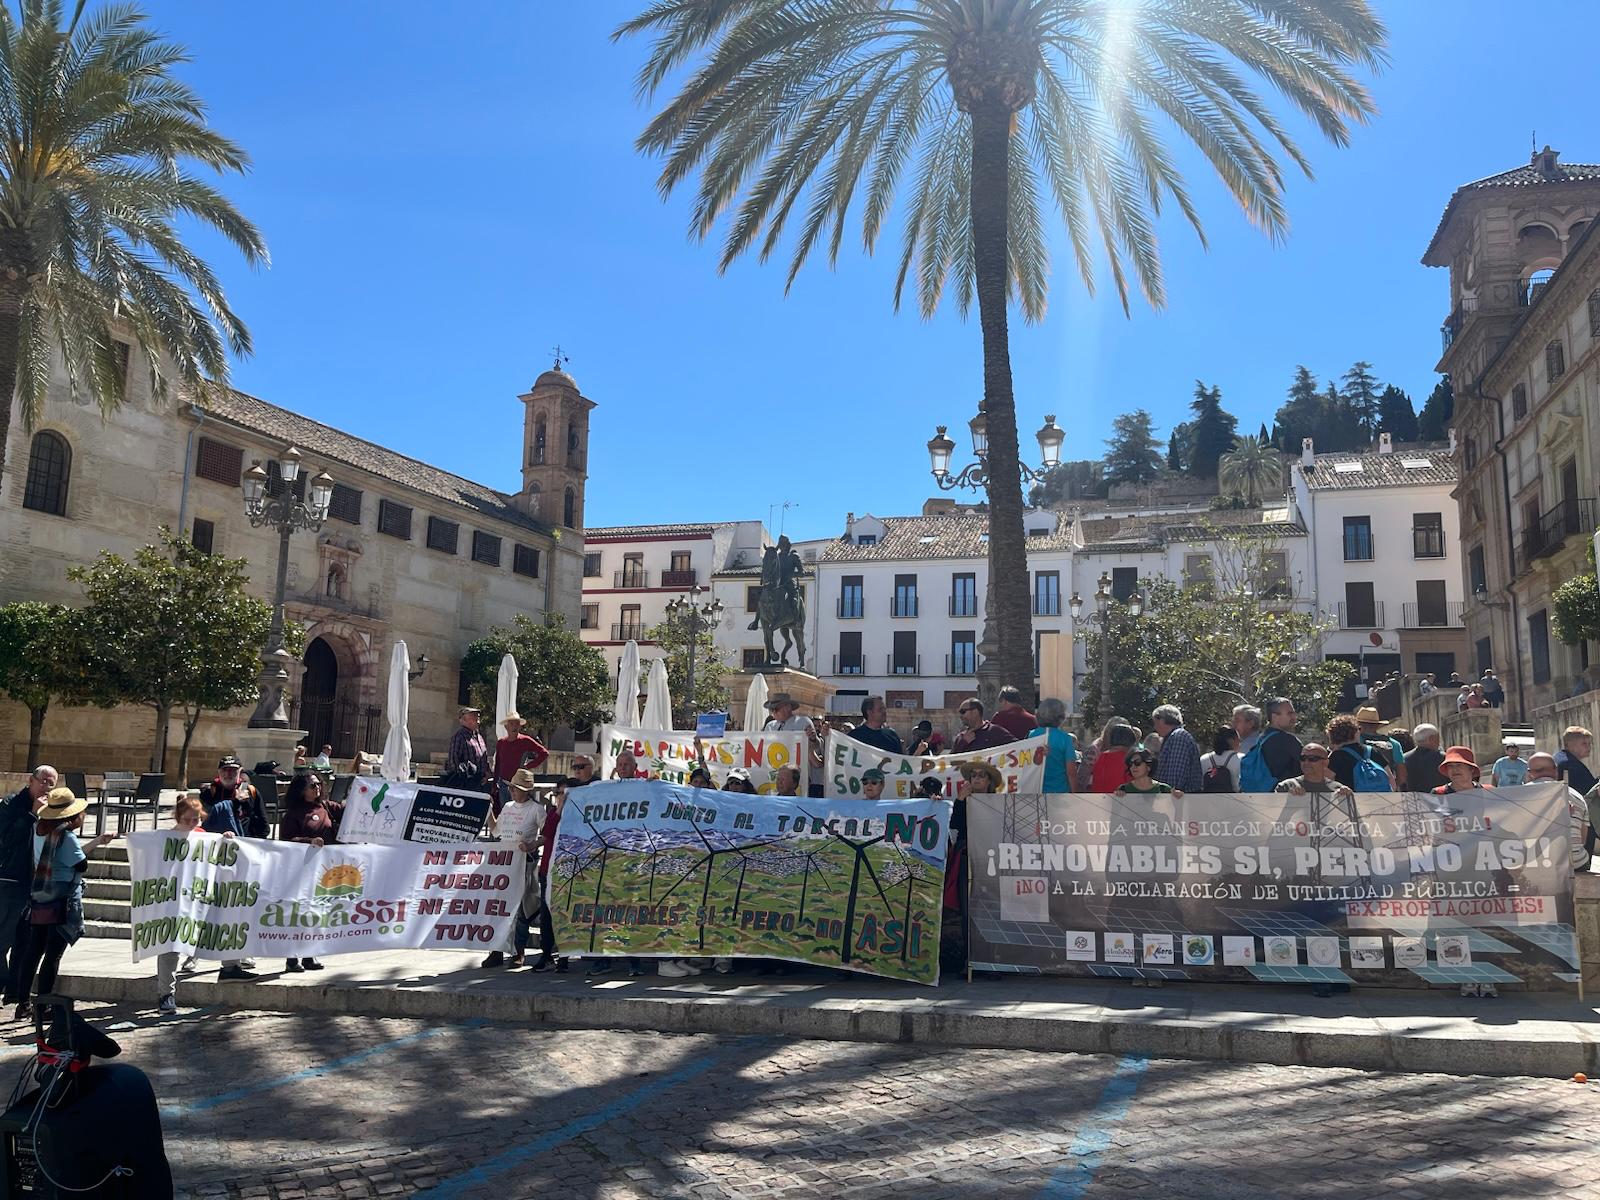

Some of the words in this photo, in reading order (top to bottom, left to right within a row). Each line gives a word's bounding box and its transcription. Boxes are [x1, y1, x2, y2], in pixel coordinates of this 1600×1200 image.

[835, 743, 862, 767] EL
[440, 795, 465, 809] NO
[415, 827, 460, 840] RENOVABLES
[583, 801, 650, 824] EOLICAS
[660, 802, 717, 824] JUNTO
[733, 813, 755, 830] AL
[778, 815, 873, 837] TORCAL
[885, 813, 939, 850] NO
[1085, 820, 1128, 837] UNA
[1392, 821, 1406, 837] Y
[1416, 816, 1492, 836] JUSTA!
[163, 838, 190, 862] NO
[191, 839, 204, 862] A
[207, 839, 240, 867] LAS
[423, 850, 448, 865] NI
[452, 850, 484, 865] EN
[487, 850, 514, 865] MI
[986, 843, 1222, 876] ¡RENOVABLES
[1233, 845, 1282, 879] SI,
[1294, 846, 1395, 876] PERO
[1407, 845, 1463, 873] NO
[132, 876, 177, 908] MEGA
[190, 876, 261, 908] PLANTAS
[423, 873, 510, 890] PUEBLO
[1052, 883, 1065, 896] A
[1071, 880, 1096, 896] LA
[1252, 884, 1279, 900] DE
[1287, 883, 1394, 901] UTILIDAD
[417, 899, 443, 915] NI
[448, 899, 480, 915] EN
[484, 899, 511, 917] EL
[1346, 896, 1544, 917] EXPROPIACIONES!
[134, 916, 250, 951] FOTOVOLTAICAS
[258, 928, 373, 941] www.alorasol.com
[434, 924, 495, 942] TUYO
[570, 903, 679, 926] RENOVABLES
[740, 909, 795, 932] PERO
[815, 916, 843, 940] NO
[855, 911, 925, 959] ASÍ
